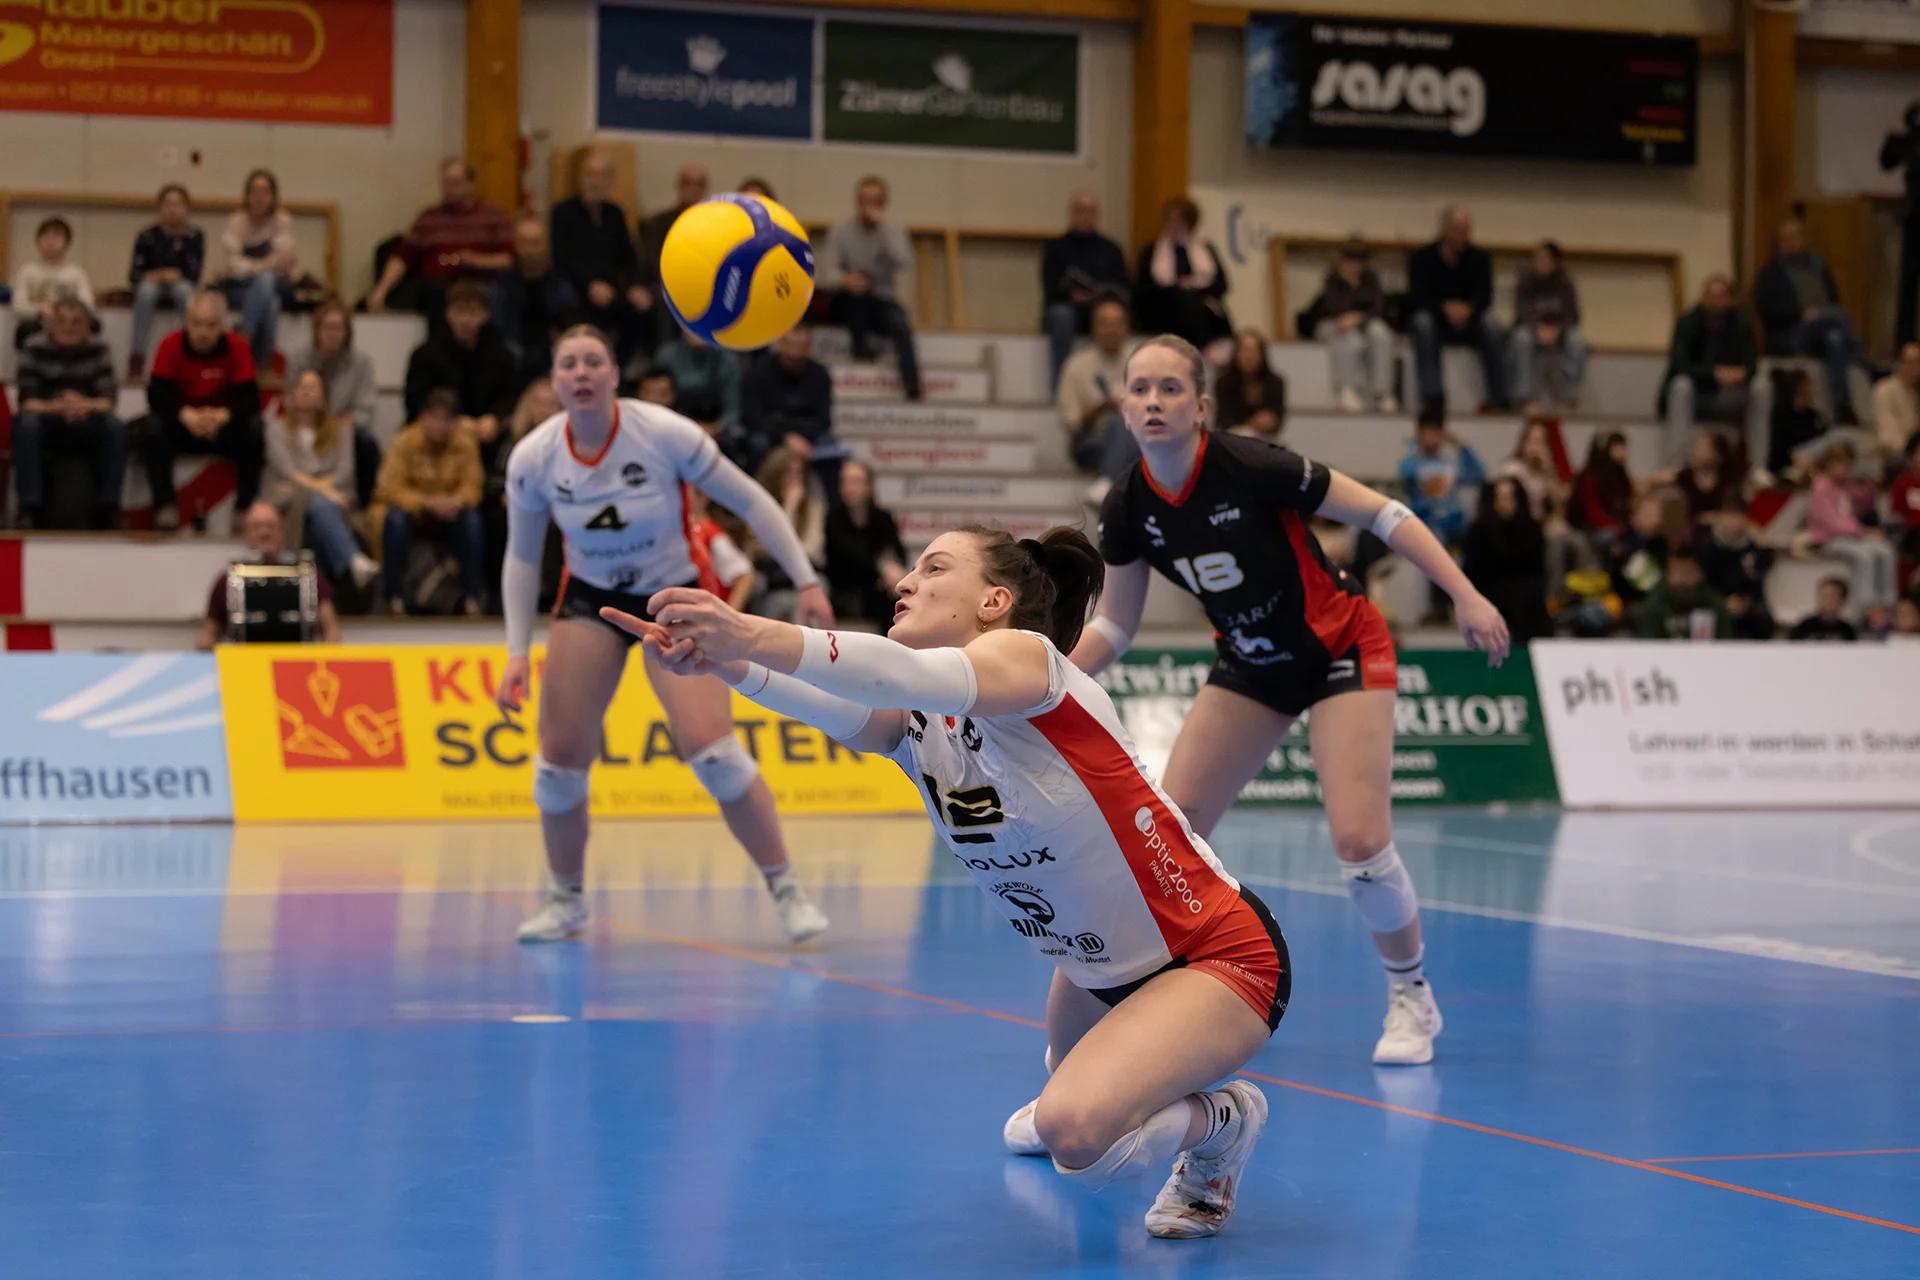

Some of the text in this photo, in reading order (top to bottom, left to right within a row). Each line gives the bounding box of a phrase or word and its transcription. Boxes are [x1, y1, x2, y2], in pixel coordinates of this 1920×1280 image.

[584, 503, 630, 532] 4
[1172, 551, 1245, 594] 18
[1134, 805, 1203, 914] Optic2000
[1148, 859, 1175, 898] PARATTE
